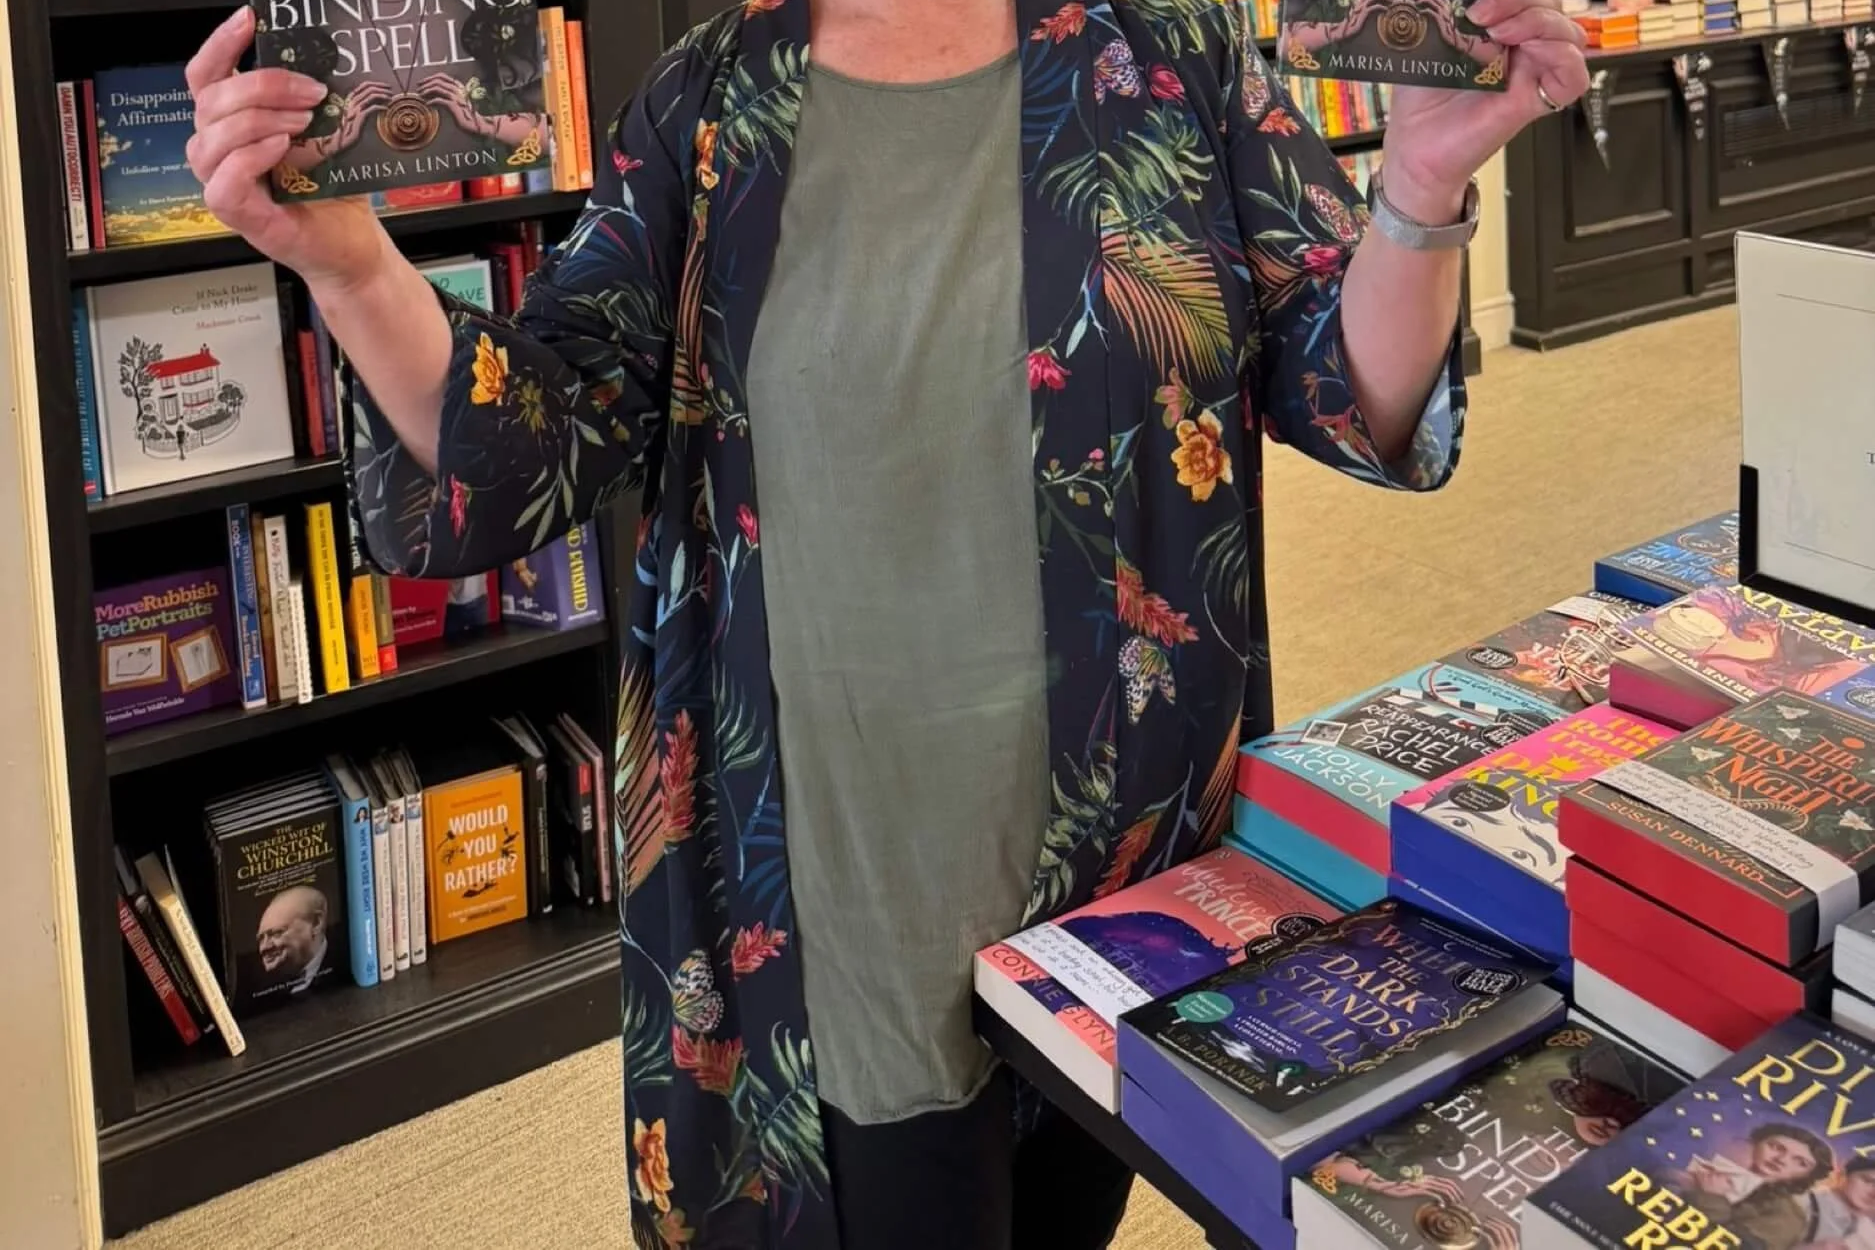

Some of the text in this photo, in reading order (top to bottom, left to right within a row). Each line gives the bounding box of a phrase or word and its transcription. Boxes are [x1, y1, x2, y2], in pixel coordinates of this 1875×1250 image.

[331, 19, 476, 77] SPELL
[1328, 53, 1468, 79] MARISA LINTON
[111, 88, 194, 108] Disappoint
[117, 108, 194, 128] Affirmatio
[328, 147, 499, 185] MARISA LINTON
[1349, 717, 1460, 766] RACHEL
[1360, 703, 1498, 758] REAPPEARANCE
[1804, 733, 1864, 770] THE
[1307, 745, 1398, 789] HOLLY
[1352, 734, 1445, 775] PRICE
[1272, 749, 1395, 810] JACKSON
[1704, 753, 1847, 816] NIGHT
[241, 821, 327, 853] WICKED WIT OF
[276, 825, 292, 834] THE
[448, 803, 508, 836] WOULD
[1607, 801, 1765, 883] SUSAN DENNARD
[237, 841, 333, 880] CHURCHILL
[246, 832, 324, 863] WINSTON
[462, 834, 498, 860] YOU
[444, 853, 518, 892] RATHER?
[1173, 881, 1268, 941] PRINCE
[992, 948, 1066, 1001] CONNIE
[1319, 953, 1439, 1014] DARK
[1379, 956, 1430, 984] THE
[1252, 987, 1366, 1060] STILL
[1274, 964, 1412, 1038] STANDS
[1786, 1037, 1875, 1092] DI
[1732, 1054, 1875, 1158] RIV
[1432, 1094, 1561, 1183] BIND
[1544, 1125, 1589, 1162] TH
[1344, 1192, 1409, 1246] MARISA
[1607, 1166, 1742, 1250] REBE
